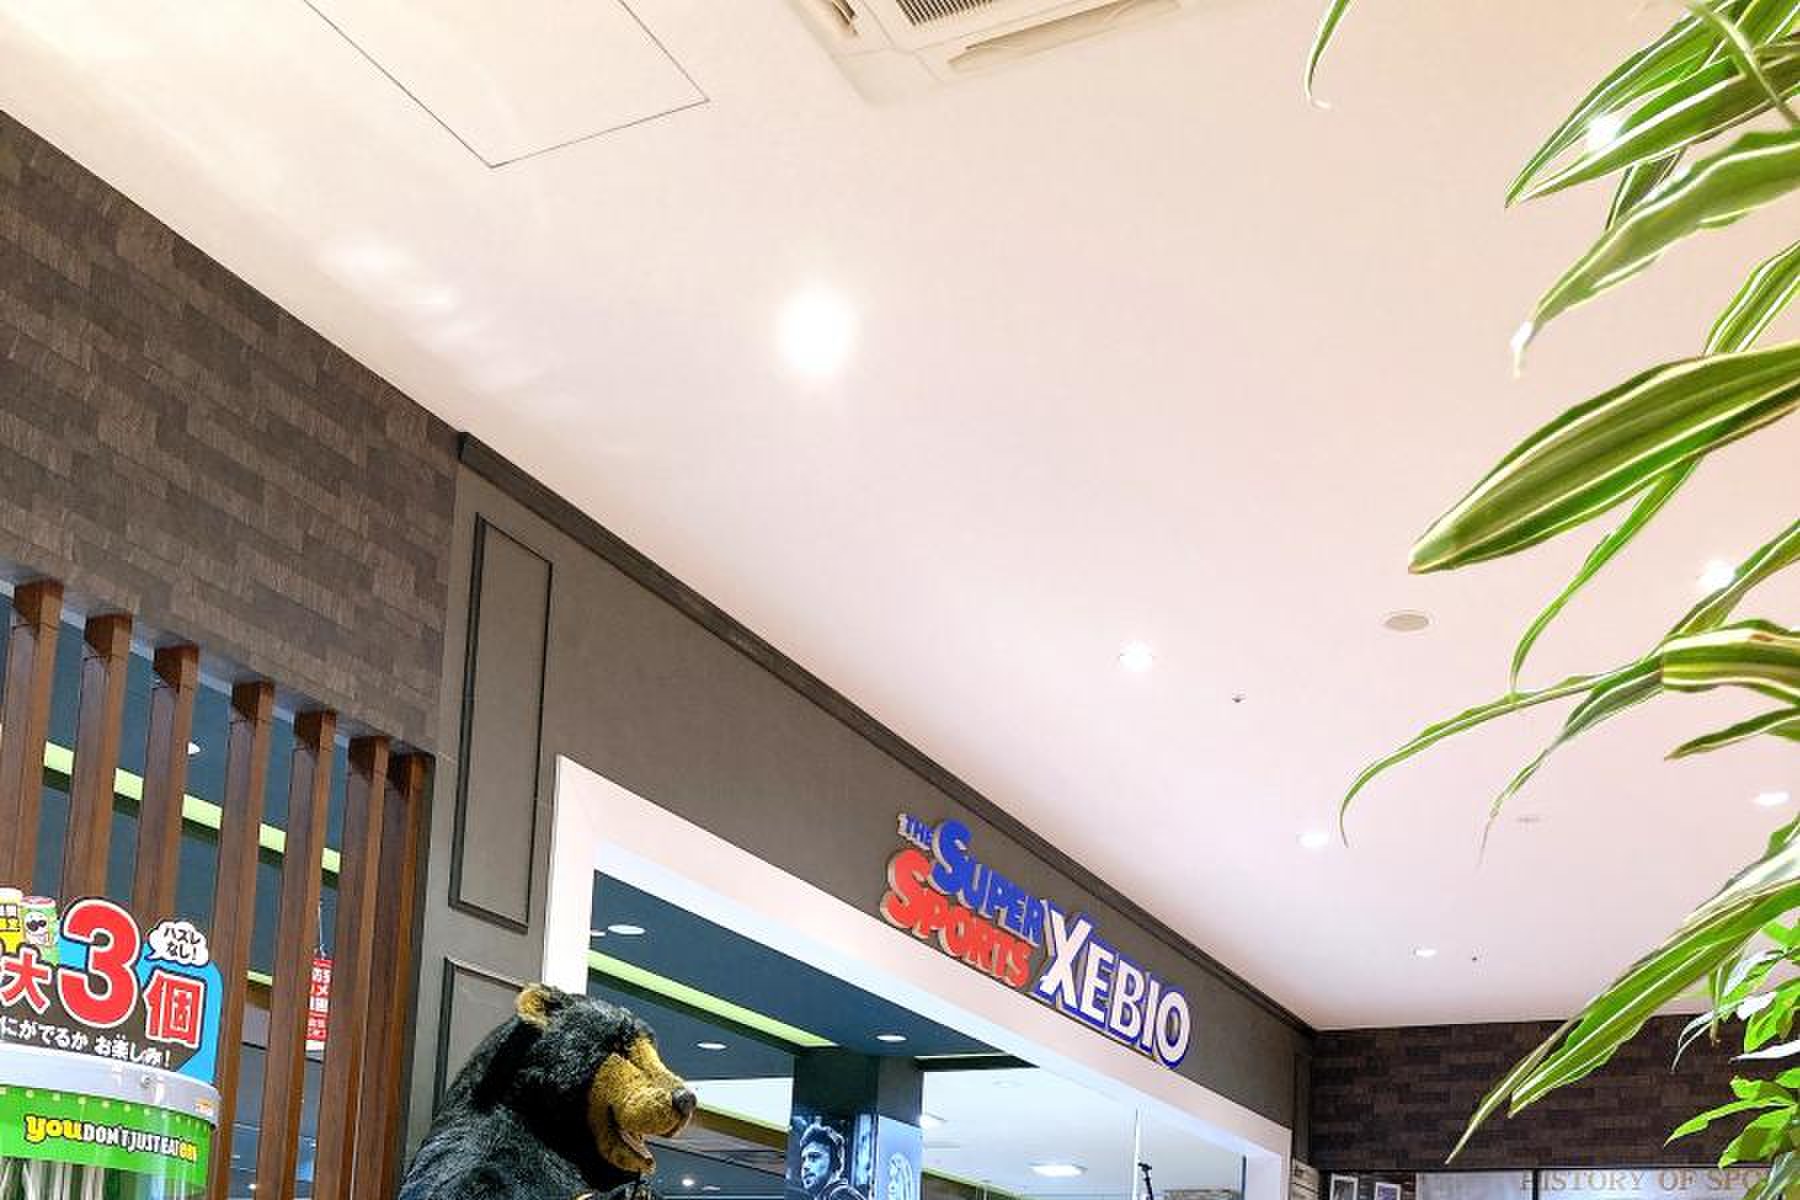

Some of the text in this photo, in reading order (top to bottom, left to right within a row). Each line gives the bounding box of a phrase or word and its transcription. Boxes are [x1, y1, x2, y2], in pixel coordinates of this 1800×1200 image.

[898, 813, 931, 849] THE
[930, 818, 1044, 946] SUPER
[880, 848, 1033, 988] SPORTS
[163, 927, 201, 945] ハズレ
[166, 940, 197, 961] なし!
[1036, 902, 1191, 1067] XEBIO
[127, 1131, 160, 1153] JUST
[1520, 1171, 1645, 1191] HISTORY
[1657, 1171, 1700, 1191] OF
